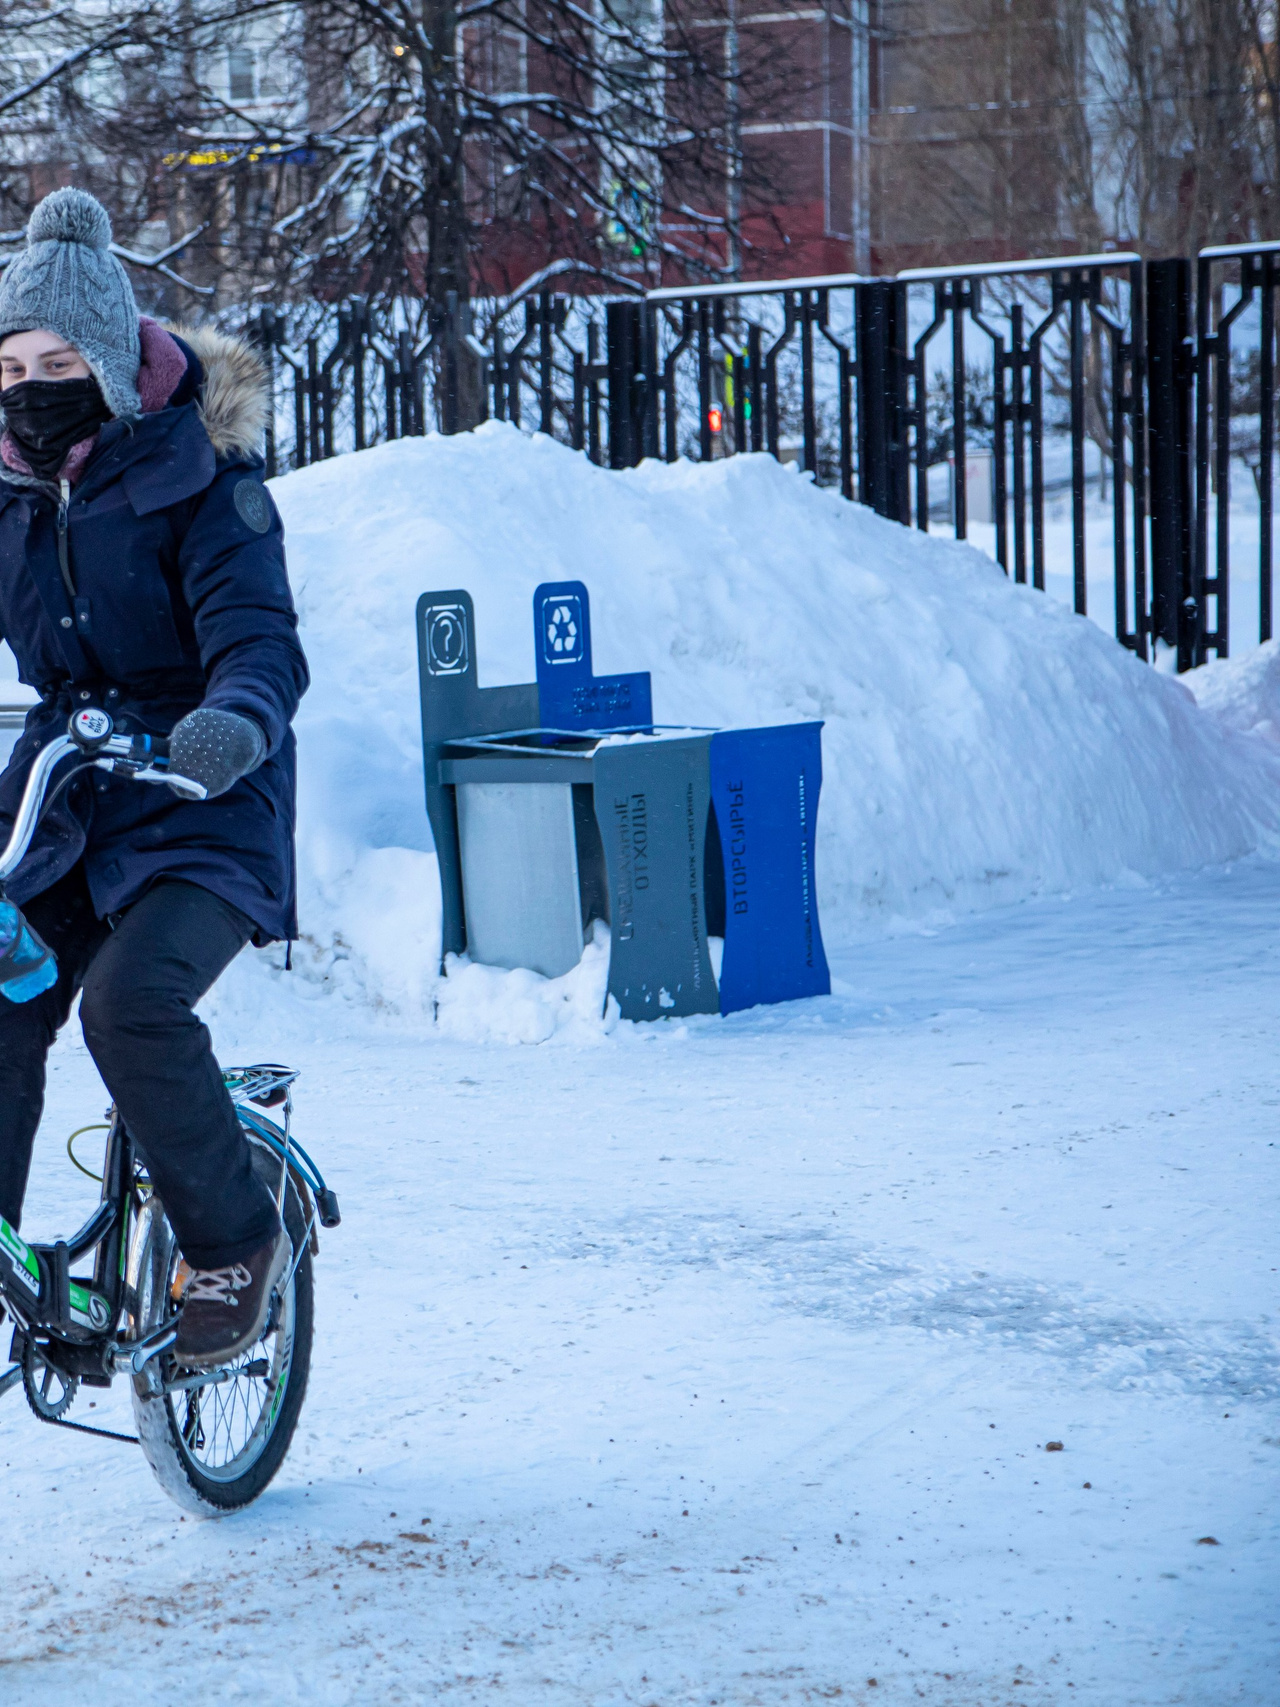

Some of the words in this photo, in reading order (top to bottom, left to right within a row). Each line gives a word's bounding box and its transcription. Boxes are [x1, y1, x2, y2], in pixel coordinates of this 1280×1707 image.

[631, 793, 649, 890] ОТХОДЫ
[690, 855, 698, 888] ПАРК
[728, 780, 748, 914] ВТОРСЫРЬЁ
[14, 1261, 37, 1288] STELS
